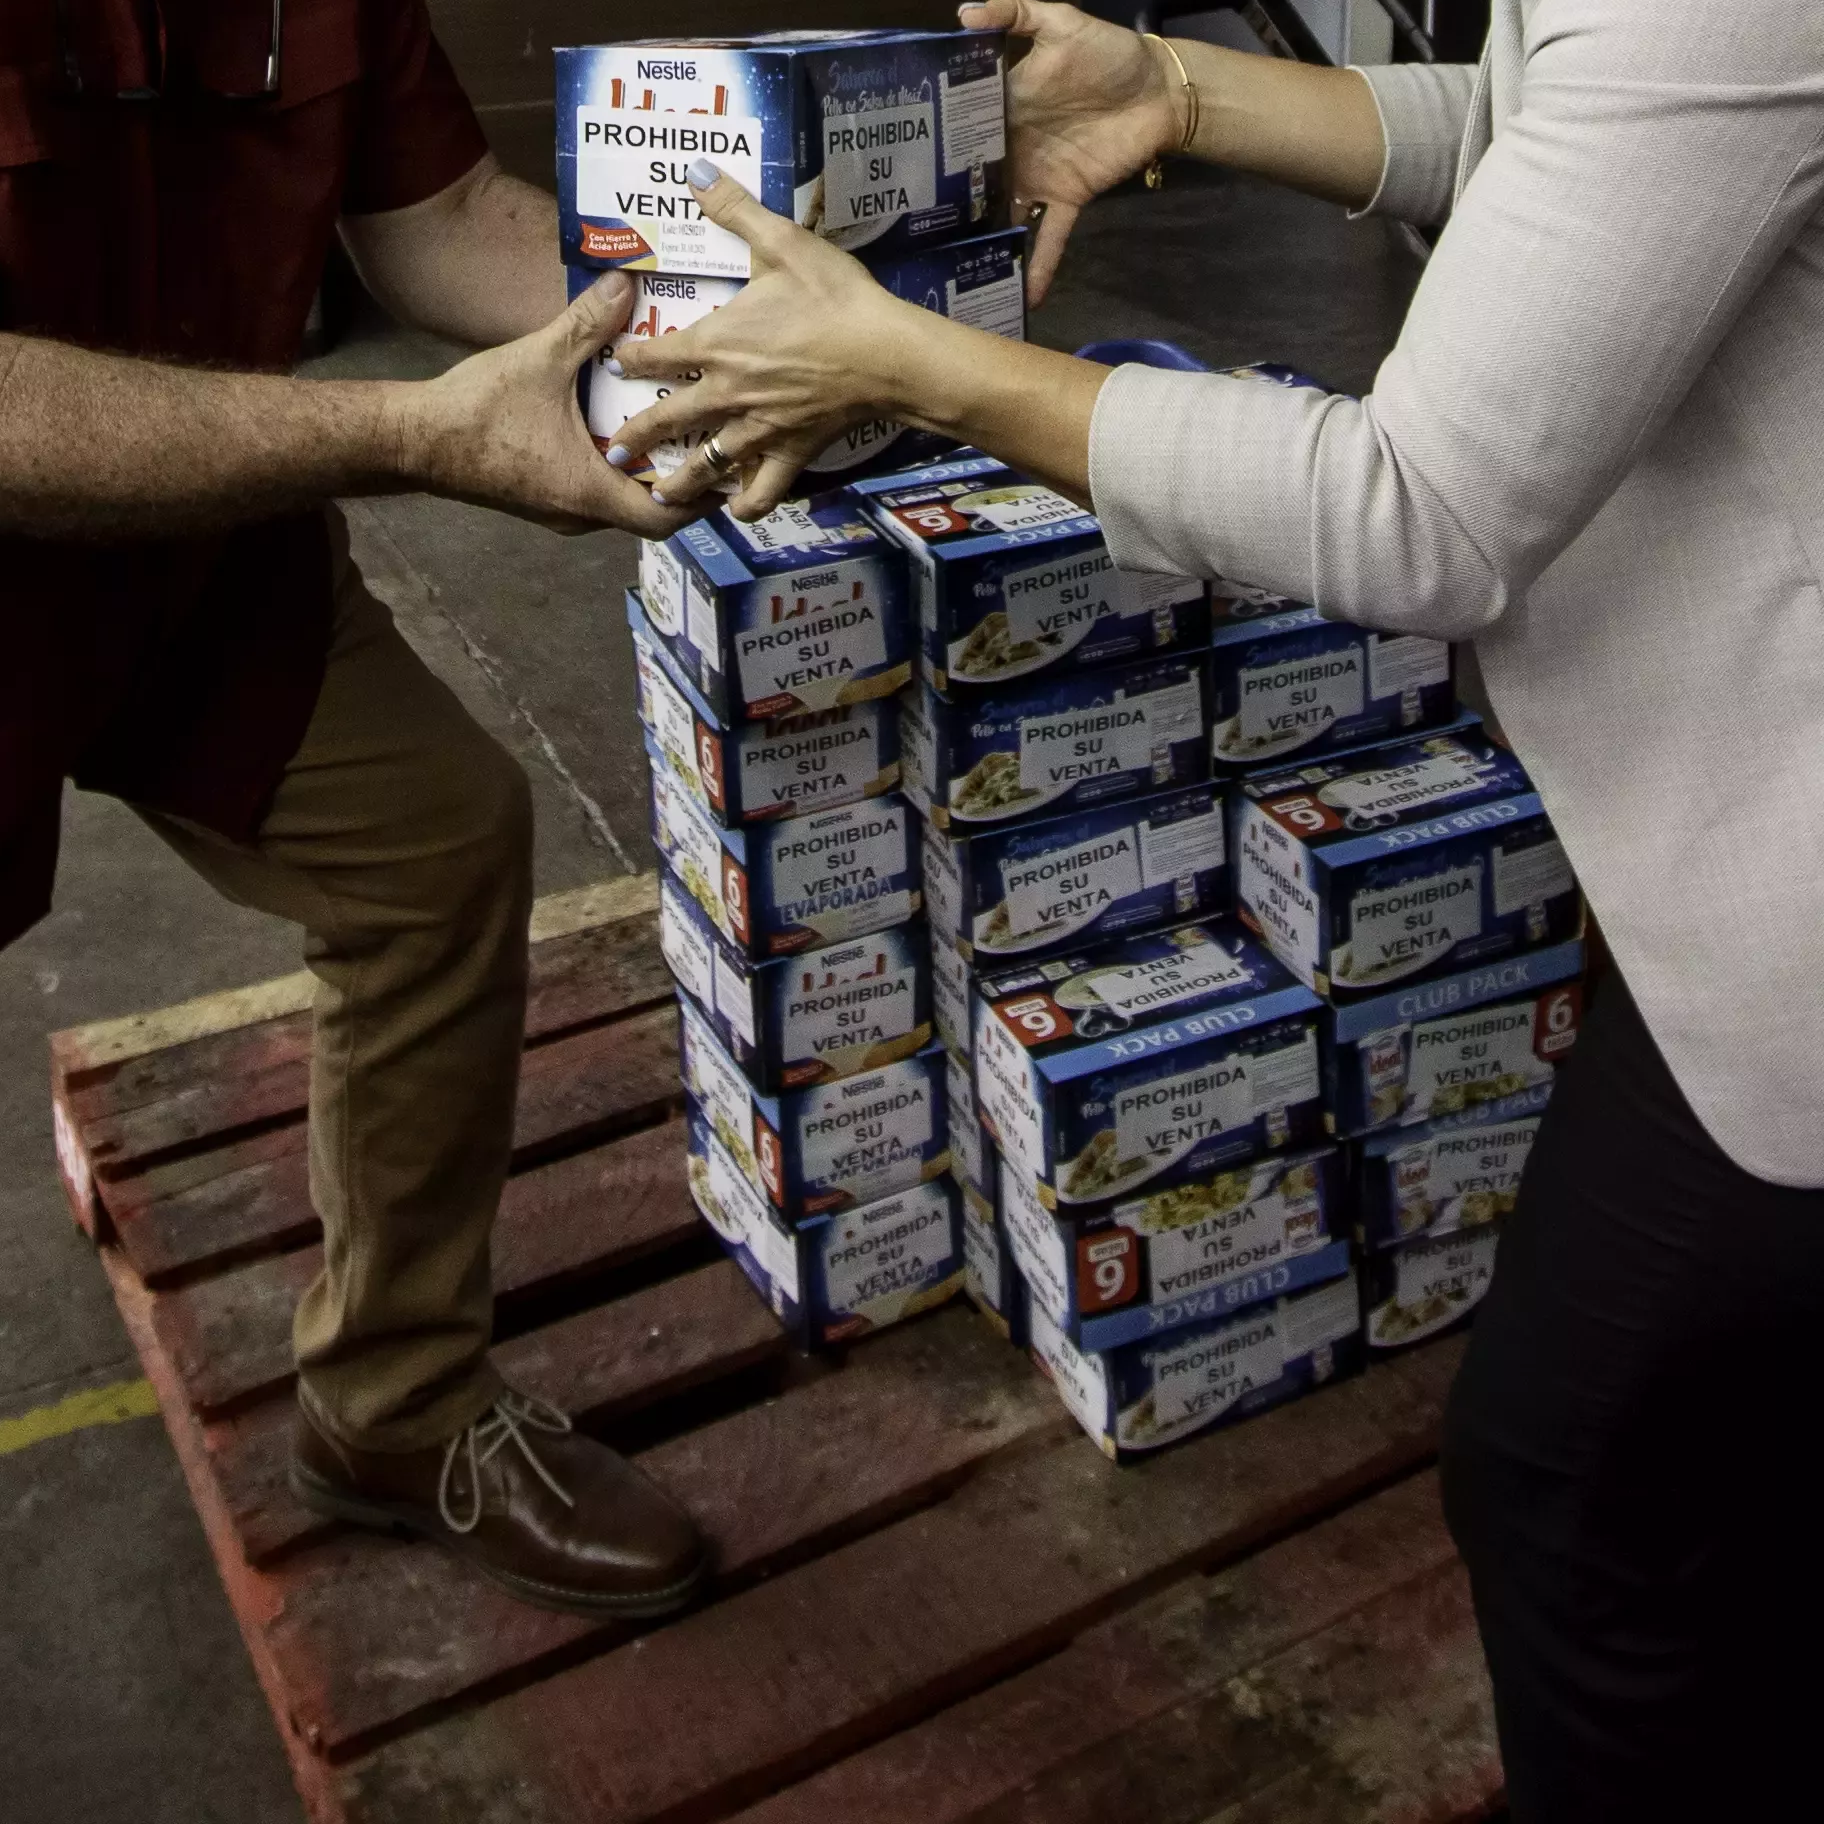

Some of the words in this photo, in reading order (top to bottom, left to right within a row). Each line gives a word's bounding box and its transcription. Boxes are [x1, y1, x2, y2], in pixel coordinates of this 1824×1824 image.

[637, 60, 697, 80] Nestlé
[845, 99, 856, 113] en
[858, 90, 884, 113] Salsa
[585, 122, 751, 156] PROHIBIDA
[829, 118, 929, 154] PROHIBIDA
[649, 161, 689, 185] SU
[869, 156, 892, 181] SU
[850, 187, 909, 218] VENTA
[589, 233, 605, 242] Con
[606, 234, 631, 242] Hierro
[589, 241, 612, 251] Ácido
[614, 242, 639, 252] Fólico
[643, 277, 696, 300] Nestlé
[685, 527, 722, 557] CLUB
[1000, 526, 1069, 545] PACK
[791, 571, 839, 593] Nestlé
[1008, 555, 1114, 599] PROHIBID
[1059, 583, 1090, 605] SU
[742, 607, 874, 656] PROHIBIDA
[1038, 600, 1112, 633] VENTA
[798, 641, 830, 663] SU
[774, 657, 854, 690] VENTA
[1245, 658, 1358, 695] PROHIBIDA
[1290, 687, 1317, 706] SU
[1026, 709, 1147, 744] PROHIBIDA
[1267, 705, 1336, 732] VENTA
[701, 736, 714, 774] 6
[746, 727, 871, 767] PROHIBIDA
[1073, 737, 1104, 757] SU
[796, 756, 826, 773] SU
[1049, 756, 1121, 783] VENTA
[1357, 764, 1429, 786] VENTA
[772, 774, 846, 802] VENTA
[1358, 776, 1476, 812] PROHIBIDA
[1387, 778, 1418, 792] SU
[1452, 805, 1518, 828] CLUB
[777, 819, 898, 863] PROHIBIDA
[1378, 824, 1450, 848] PACK
[827, 849, 855, 869] SU
[1008, 839, 1131, 893] PROHIBIDA
[728, 868, 740, 904] 6
[803, 866, 876, 896] VENTA
[1059, 872, 1090, 894] SU
[1243, 842, 1315, 918] PROHIBIDA
[1037, 891, 1112, 923] VENTA
[1269, 887, 1288, 913] SU
[1356, 877, 1476, 922] PROHIBIDA
[1256, 893, 1300, 946] VENTA
[1403, 910, 1434, 930] SU
[1379, 926, 1452, 960] VENTA
[1118, 952, 1195, 980] VENTA
[1149, 968, 1183, 985] SU
[789, 978, 908, 1018] PROHIBIDA
[1116, 970, 1242, 1010] PROHIBIDA
[1397, 983, 1461, 1019] CLUB
[1468, 962, 1531, 1003] PACK
[836, 1007, 865, 1027] SU
[1189, 1005, 1256, 1037] CLUB
[1549, 994, 1574, 1034] 6
[812, 1025, 884, 1053] VENTA
[1109, 1028, 1183, 1058] PACK
[1416, 1012, 1530, 1050] PROHIBIDA
[1460, 1041, 1488, 1061] SU
[979, 1043, 1039, 1127] PROHIBIDA
[1435, 1059, 1503, 1087] VENTA
[1119, 1066, 1246, 1116] PROHIBIDA
[805, 1090, 924, 1139] PROHIBIDA
[1171, 1100, 1203, 1122] SU
[854, 1123, 883, 1143] SU
[990, 1098, 1027, 1155] VENTA
[1144, 1118, 1223, 1150] VENTA
[832, 1137, 903, 1169] VENTA
[1437, 1128, 1536, 1158] PROHIBID
[1480, 1152, 1508, 1170] SU
[830, 1209, 943, 1268] PROHIBIDA
[1182, 1206, 1256, 1242] VENTA
[876, 1245, 905, 1266] SU
[1204, 1236, 1233, 1258] SU
[1446, 1253, 1472, 1271] SU
[856, 1256, 923, 1296] VENTA
[1160, 1239, 1281, 1294] PROHIBIDA
[1423, 1265, 1489, 1298] VENTA
[1225, 1267, 1290, 1304] CLUB
[1149, 1292, 1217, 1327] PACK
[1160, 1325, 1276, 1380] PROHIBIDA
[1206, 1363, 1236, 1385] SU
[1182, 1375, 1255, 1415] VENTA
